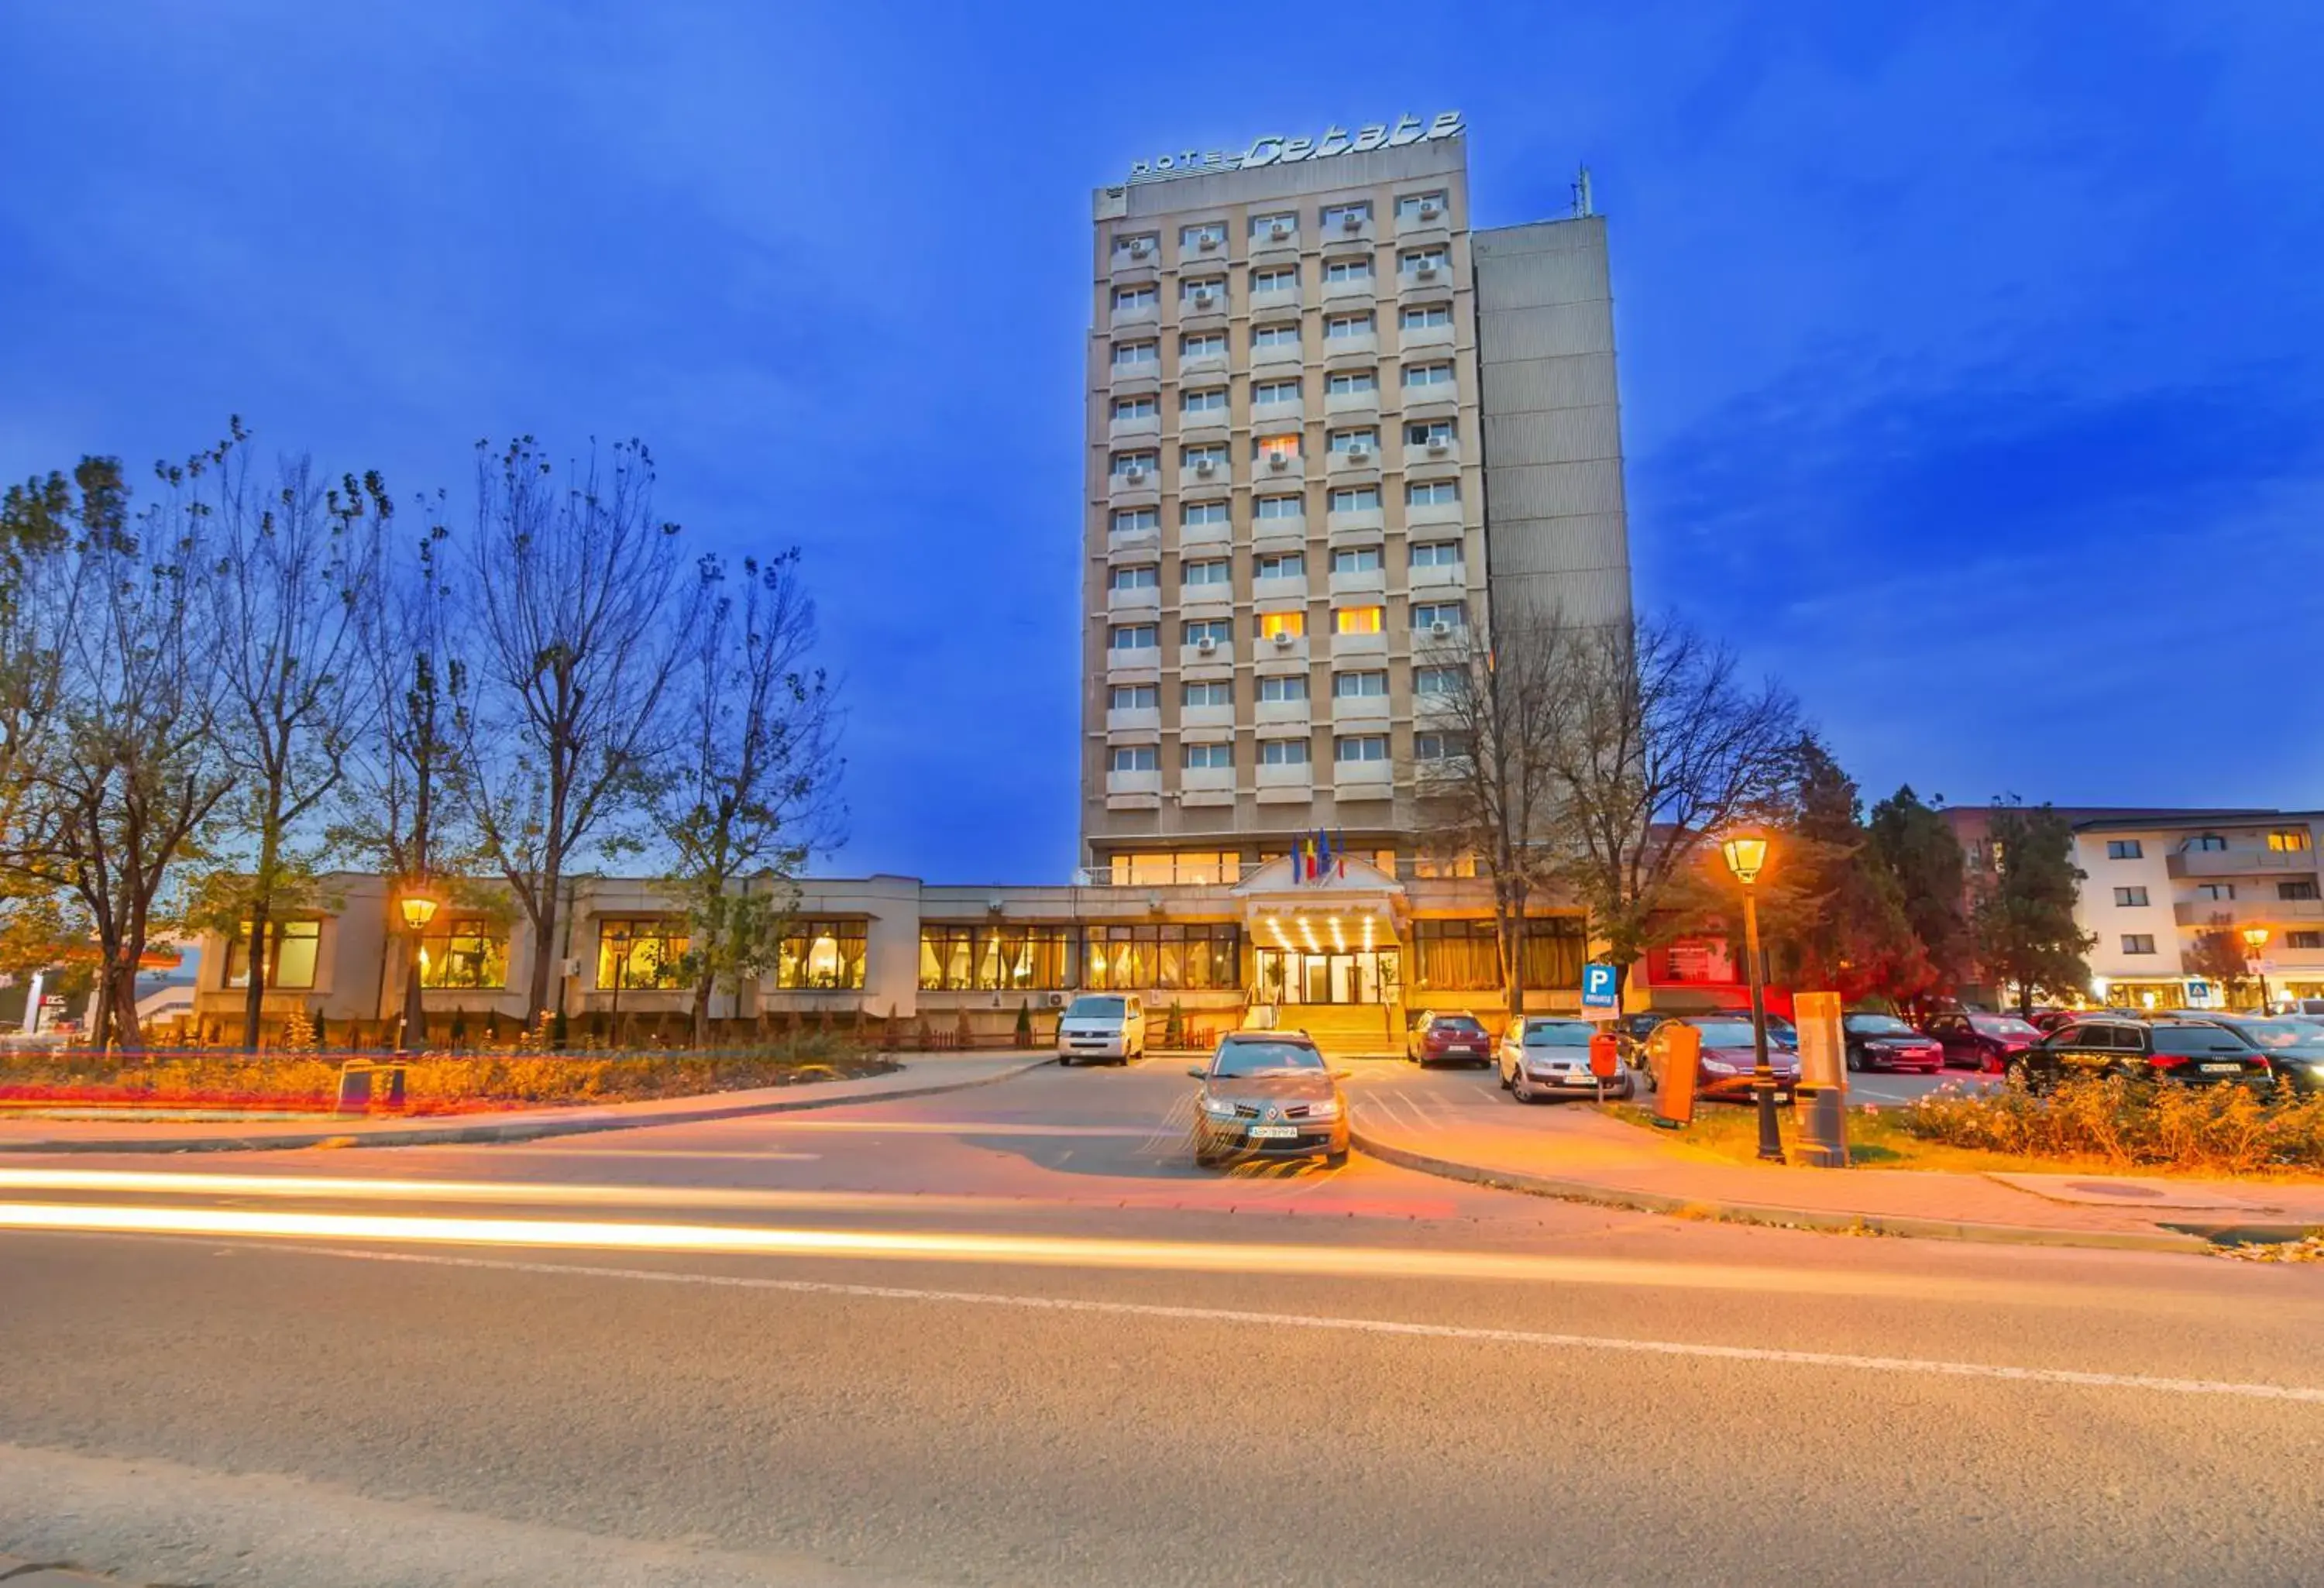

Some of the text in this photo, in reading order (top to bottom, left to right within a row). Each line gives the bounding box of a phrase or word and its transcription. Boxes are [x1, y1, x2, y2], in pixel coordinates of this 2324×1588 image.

[1133, 111, 1466, 174] HOTEL Cetate
[1590, 970, 1608, 993] P
